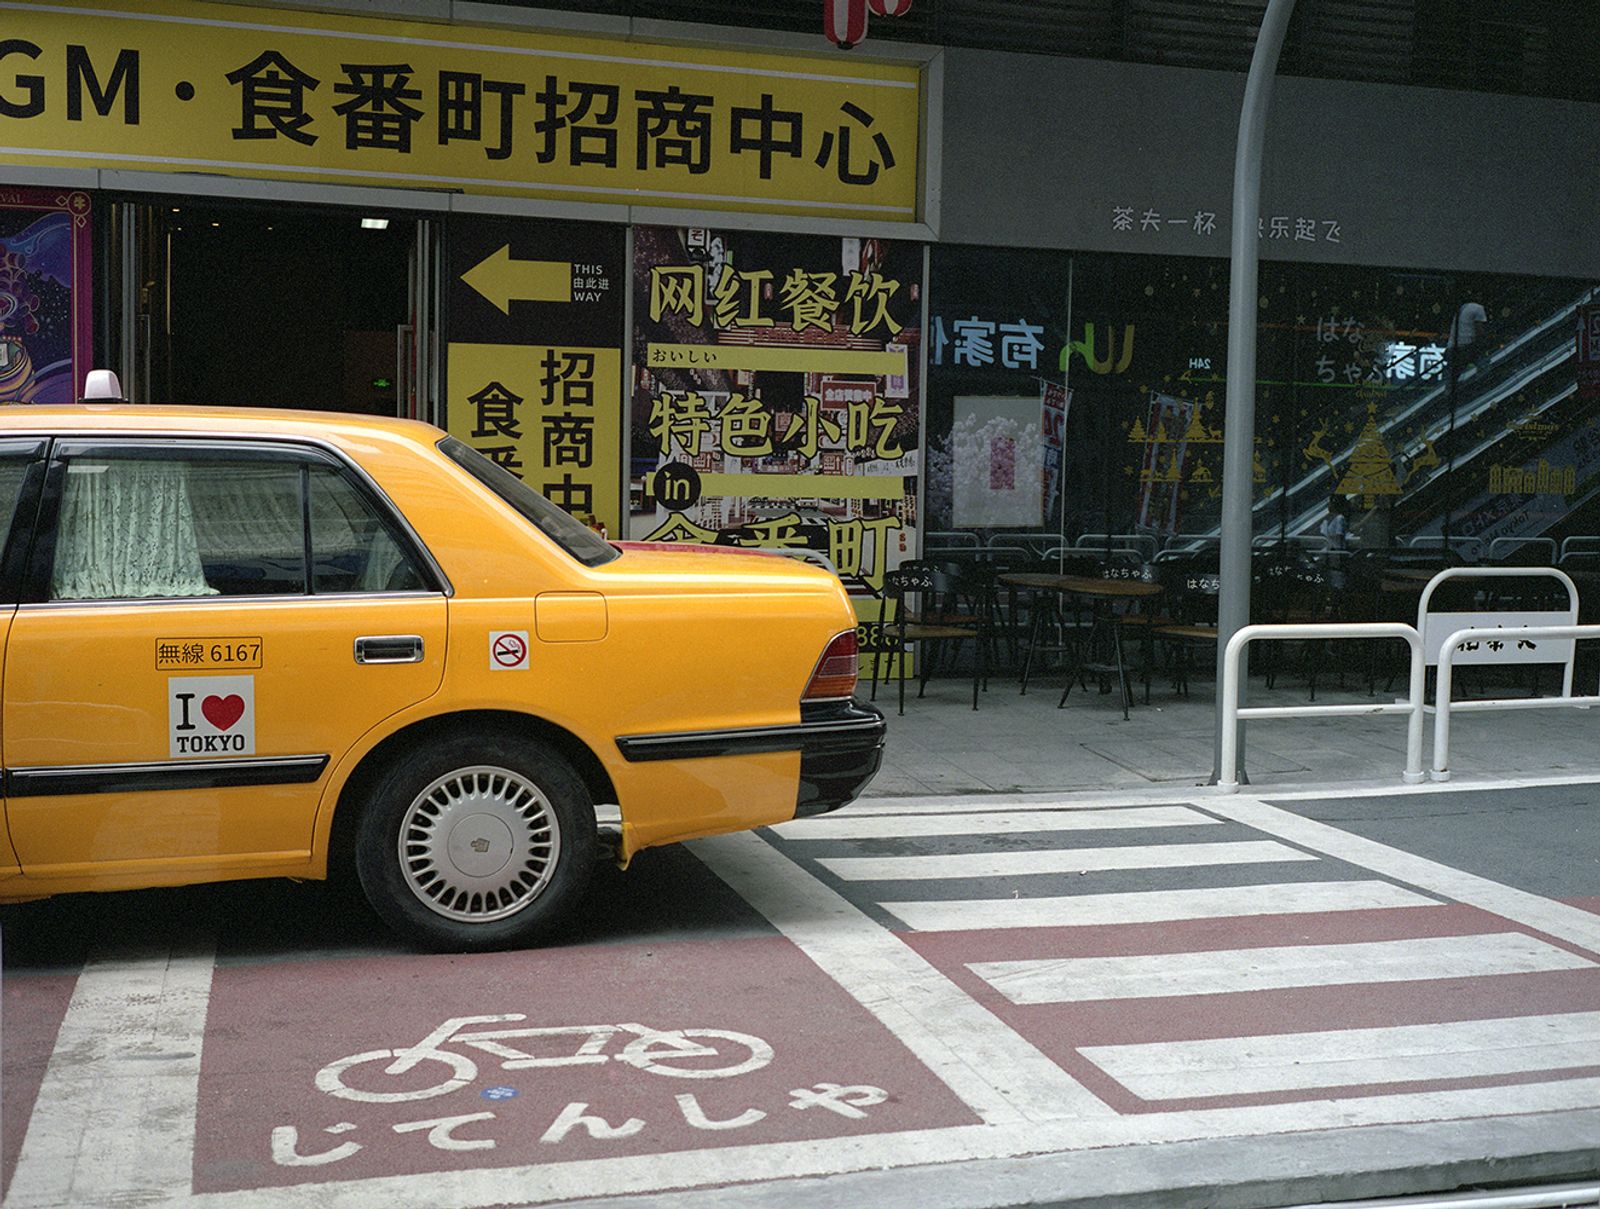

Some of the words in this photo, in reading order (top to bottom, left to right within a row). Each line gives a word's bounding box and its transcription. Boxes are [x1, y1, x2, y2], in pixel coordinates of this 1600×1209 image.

[1112, 206, 1217, 236] 茶夫一杯
[573, 263, 603, 275] THIS
[573, 276, 610, 290] 由此进
[573, 291, 602, 302] WAY
[648, 263, 904, 336] 网红餐饮
[1316, 315, 1365, 344] はな
[652, 348, 718, 364] おいしい
[648, 391, 905, 460] 特色小吃
[663, 471, 691, 501] in
[158, 643, 205, 665] 無線
[211, 643, 261, 663] 6167
[175, 693, 196, 731] I
[176, 734, 246, 753] TOKYO
